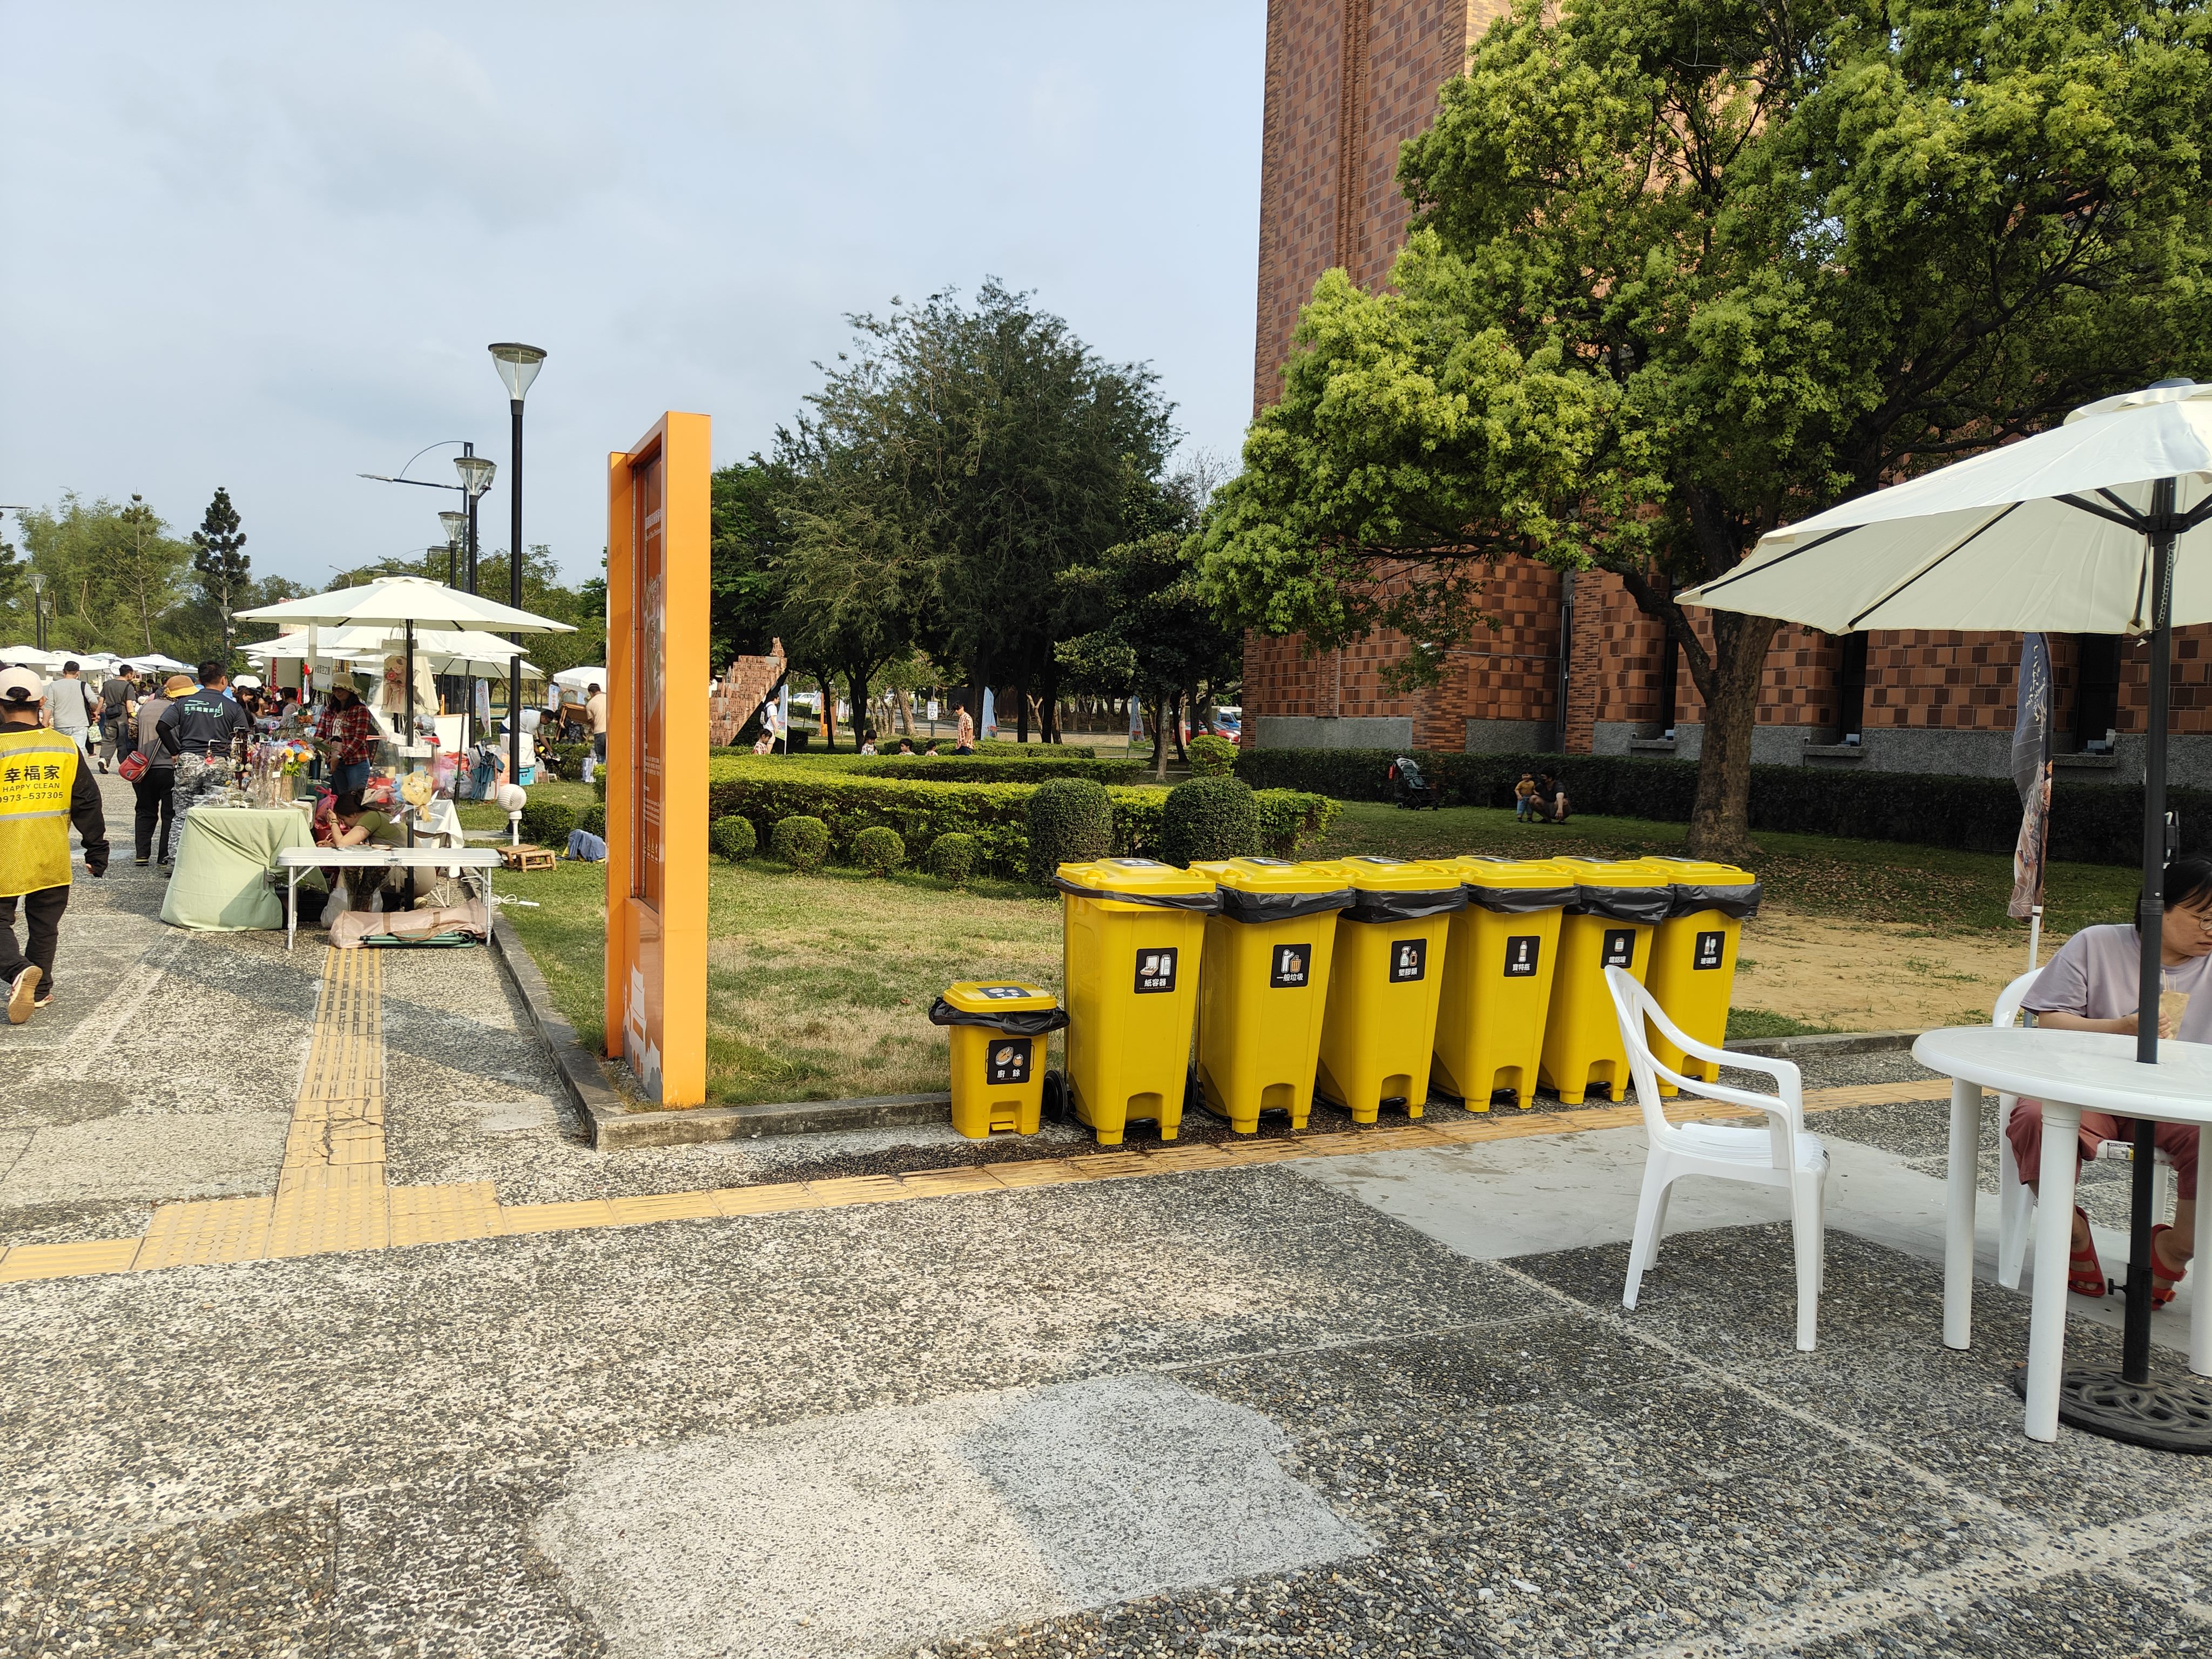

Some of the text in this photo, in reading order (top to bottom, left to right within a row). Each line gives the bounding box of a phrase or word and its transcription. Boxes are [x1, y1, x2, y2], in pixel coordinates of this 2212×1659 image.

[4, 765, 60, 783] 幸福家
[3, 784, 31, 792] HAPPY
[1398, 967, 1418, 976] 塑膠類
[1276, 973, 1303, 981] 一般垃圾
[1144, 978, 1166, 987] 紙容器
